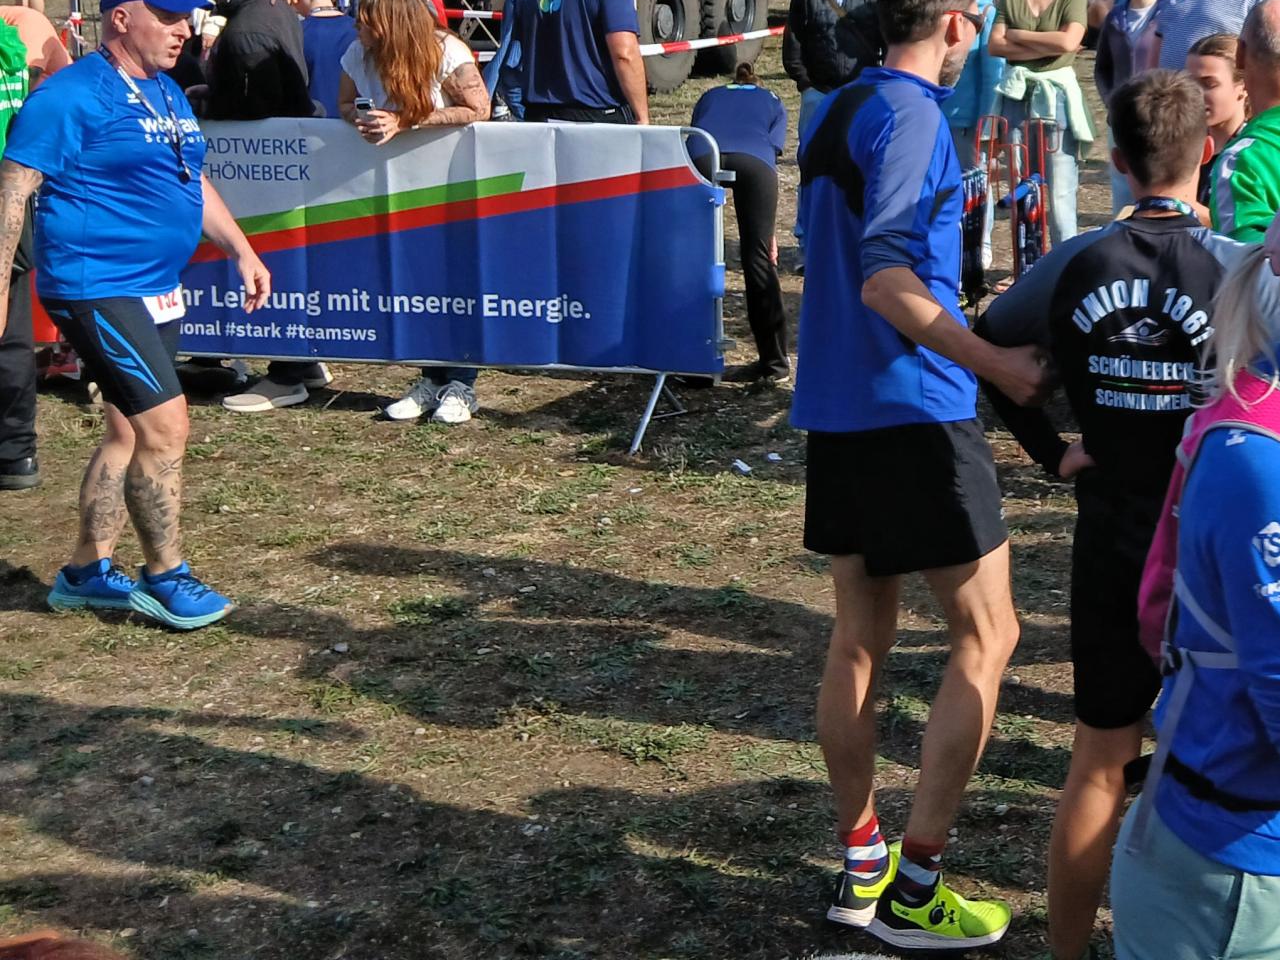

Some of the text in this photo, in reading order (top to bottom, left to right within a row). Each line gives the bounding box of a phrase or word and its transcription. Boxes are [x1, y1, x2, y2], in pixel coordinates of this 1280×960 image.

[205, 137, 308, 156] ADTWERKE
[203, 160, 310, 181] HÖNEBECK
[180, 282, 592, 324] hr Leiung mit unserer Energie.
[1071, 278, 1216, 347] UNION 1861
[179, 320, 377, 341] ional #stark #teamsws
[1088, 354, 1196, 382] SCHÖNEBECK
[1095, 388, 1192, 412] SCHWIMMEN
